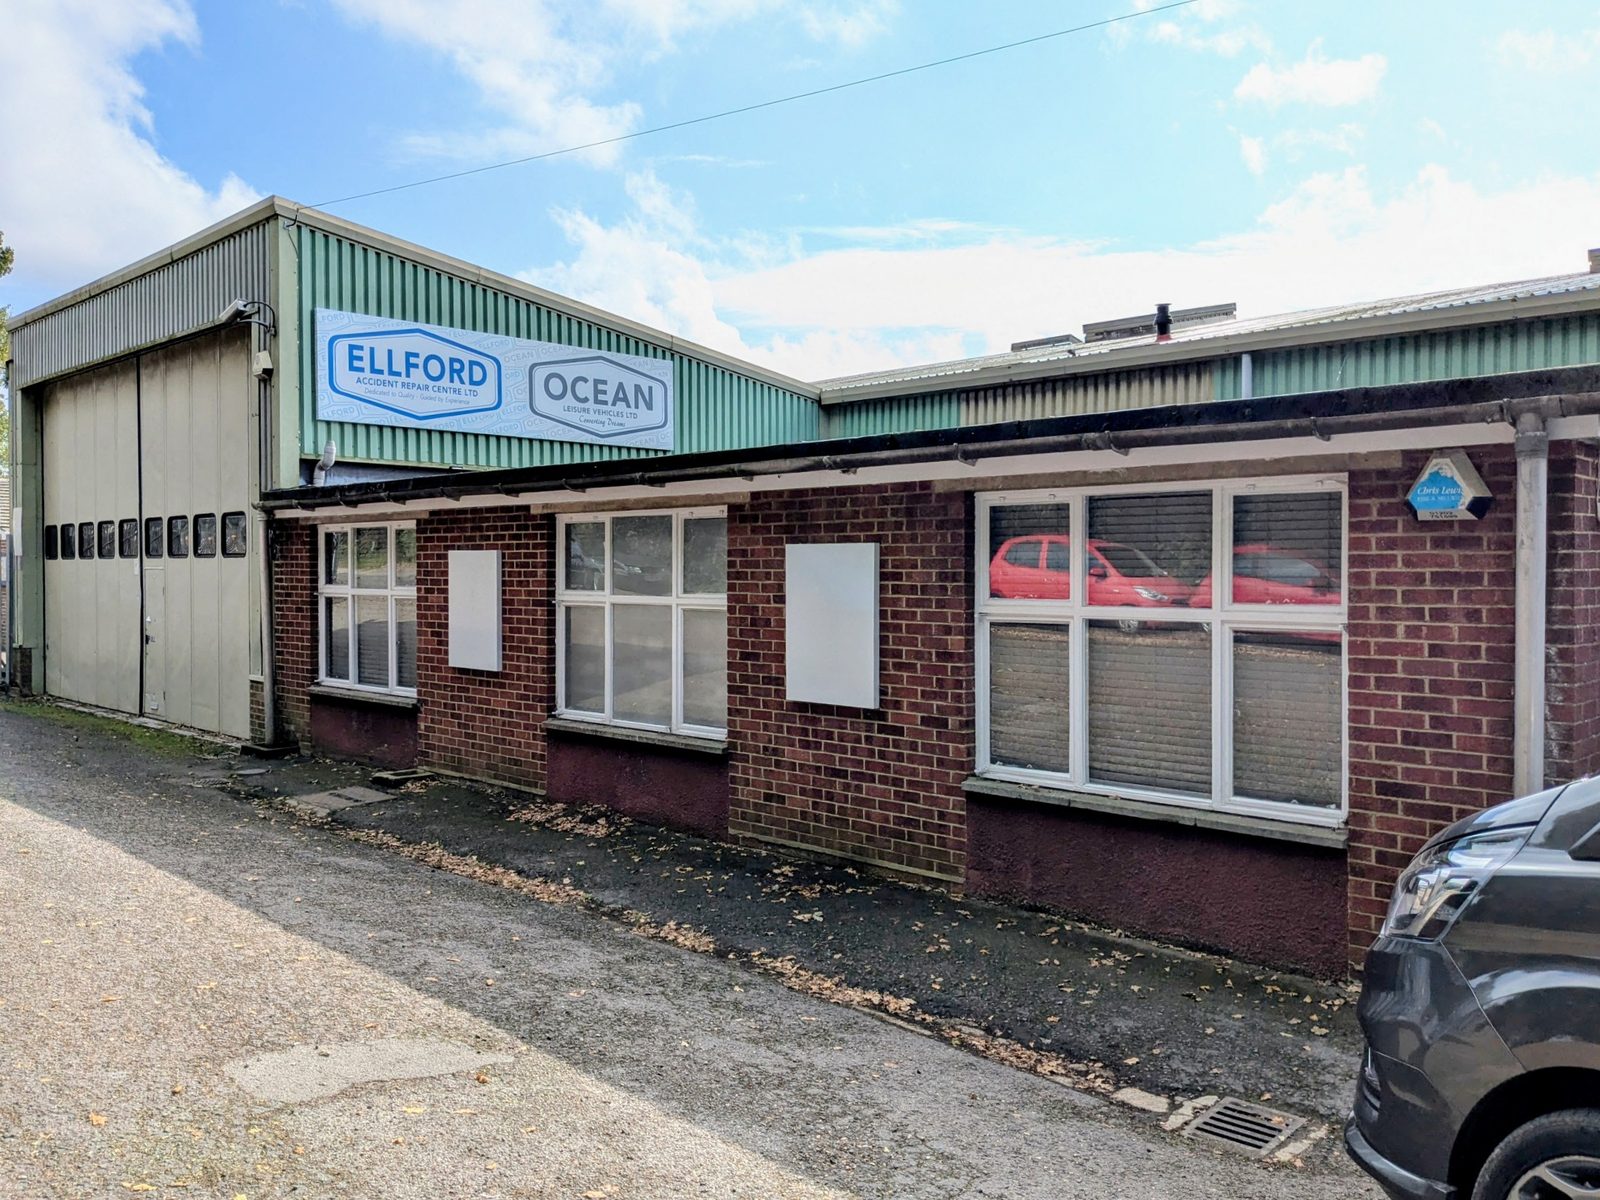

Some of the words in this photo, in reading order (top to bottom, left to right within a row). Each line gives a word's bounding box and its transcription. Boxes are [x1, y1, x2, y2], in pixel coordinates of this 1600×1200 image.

[347, 343, 488, 387] ELLFORD
[355, 376, 398, 389] ACCIDENT
[401, 382, 430, 392] REPAIR
[432, 385, 462, 396] CENTRE
[464, 388, 479, 397] LTD
[543, 372, 654, 411] OCEAN
[364, 387, 390, 397] Dedicated
[398, 391, 415, 401] Quality
[419, 394, 437, 402] Guided
[444, 397, 470, 406] Experience
[563, 405, 591, 415] LEISURE
[592, 408, 624, 418] VEHICLES
[625, 411, 638, 420] LTD
[578, 414, 606, 428] Converting
[607, 417, 626, 428] Dreams
[1417, 486, 1439, 495] Chris
